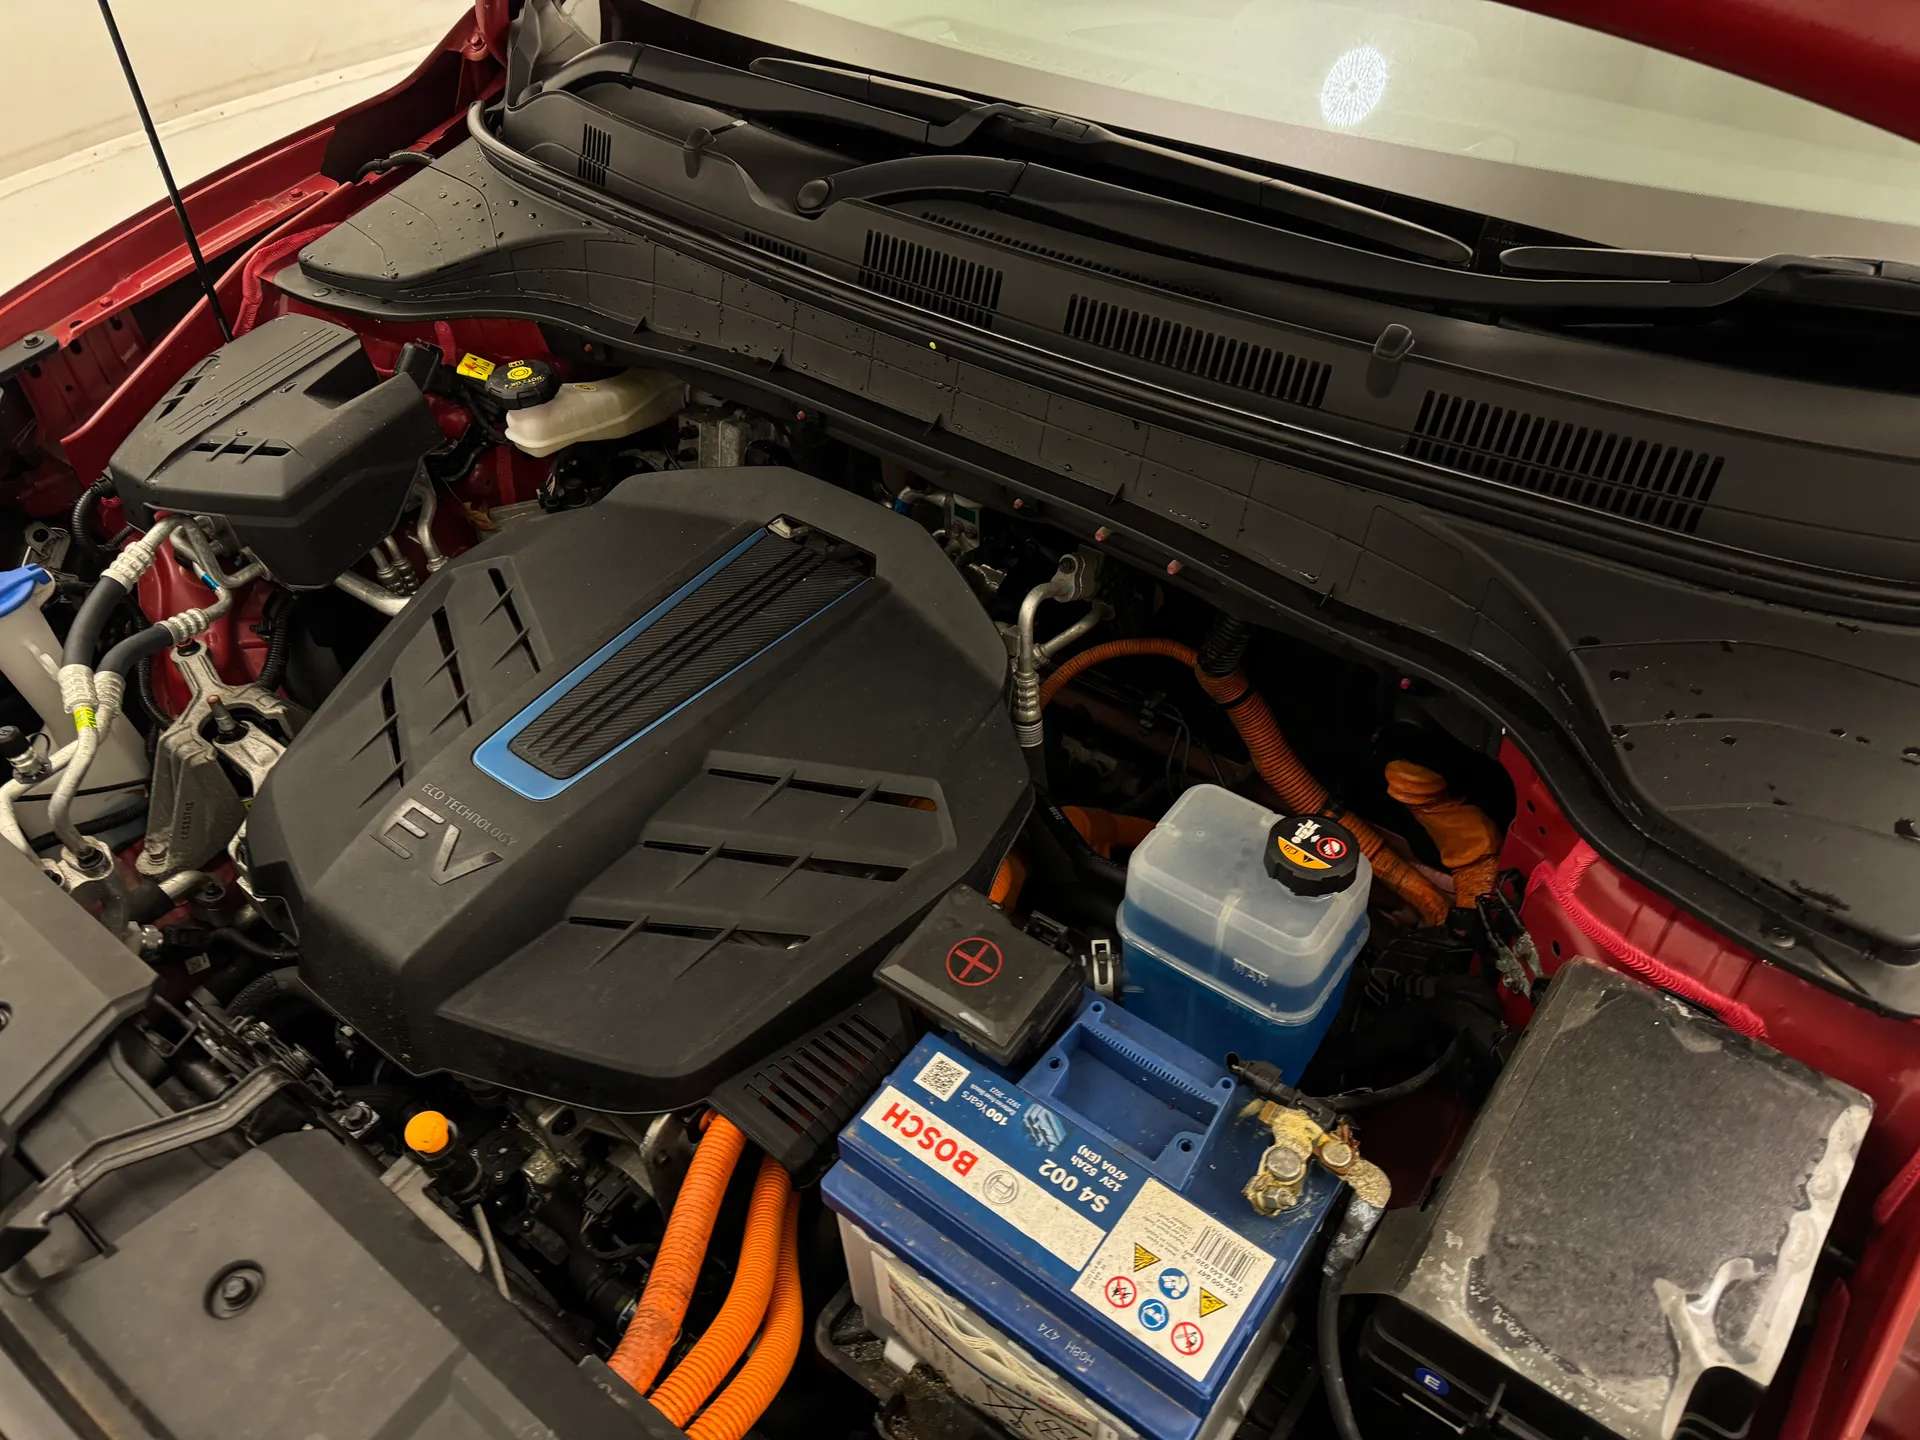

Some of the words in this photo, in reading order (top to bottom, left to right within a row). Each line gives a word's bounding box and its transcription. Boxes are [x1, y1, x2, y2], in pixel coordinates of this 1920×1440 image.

[422, 783, 446, 801] ECO
[444, 796, 519, 847] TECHNOLOGY
[368, 797, 504, 887] EV
[960, 1090, 987, 1112] Years
[985, 1106, 1008, 1127] 100
[881, 1102, 978, 1178] BOSCH
[1077, 1144, 1102, 1164] (EN)
[1037, 1158, 1079, 1193] 002
[1070, 1155, 1098, 1176] 52Ah
[1100, 1161, 1129, 1182] 470A
[1098, 1175, 1122, 1193] 12V
[1077, 1186, 1110, 1213] S4
[1424, 1374, 1440, 1390] E
